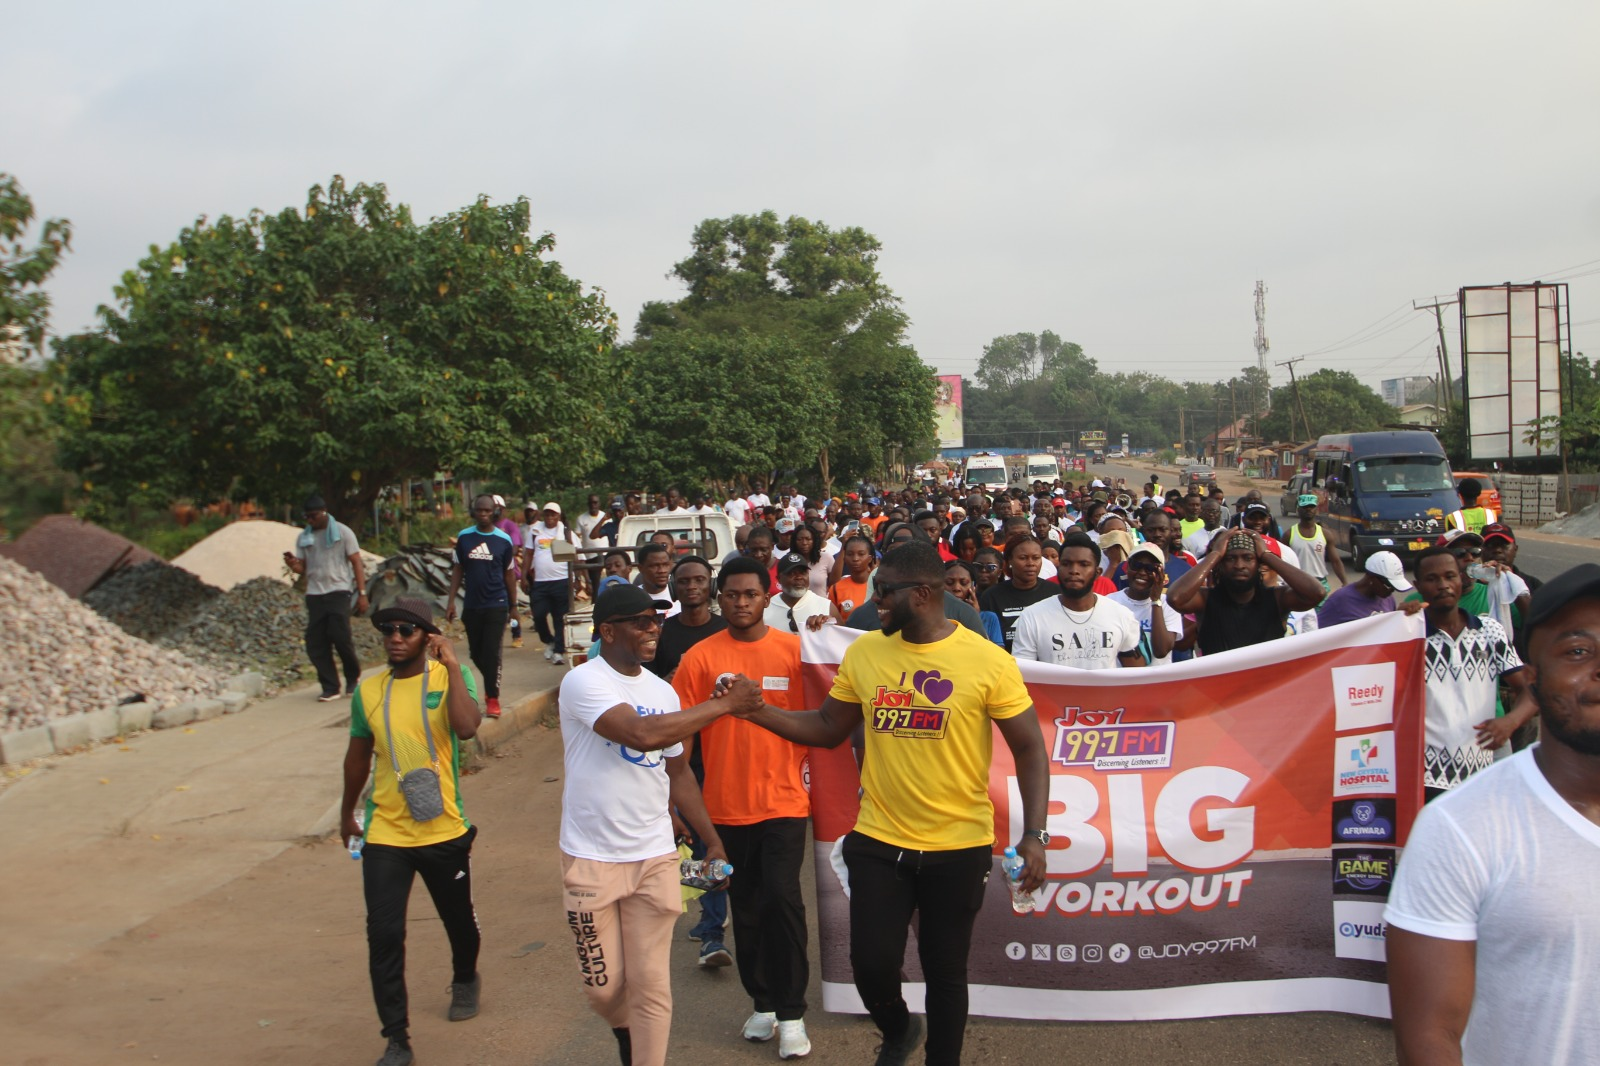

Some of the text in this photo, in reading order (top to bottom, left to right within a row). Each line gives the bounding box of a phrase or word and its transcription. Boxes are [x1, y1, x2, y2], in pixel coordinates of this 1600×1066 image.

[899, 672, 906, 686] I
[873, 687, 913, 707] JOY
[1348, 684, 1384, 700] Reedy
[912, 711, 939, 728] FM
[1059, 708, 1121, 726] JOY
[1122, 730, 1161, 753] FM
[1097, 759, 1129, 768] Discerning
[1131, 758, 1158, 766] Listeners
[1340, 774, 1389, 786] HOSPITAL
[1007, 766, 1255, 875] BIG
[1343, 826, 1386, 835] AFRIWARA
[1339, 860, 1388, 876] GAME
[580, 911, 608, 987] CULTURE
[1138, 935, 1257, 959] @JOY997FM
